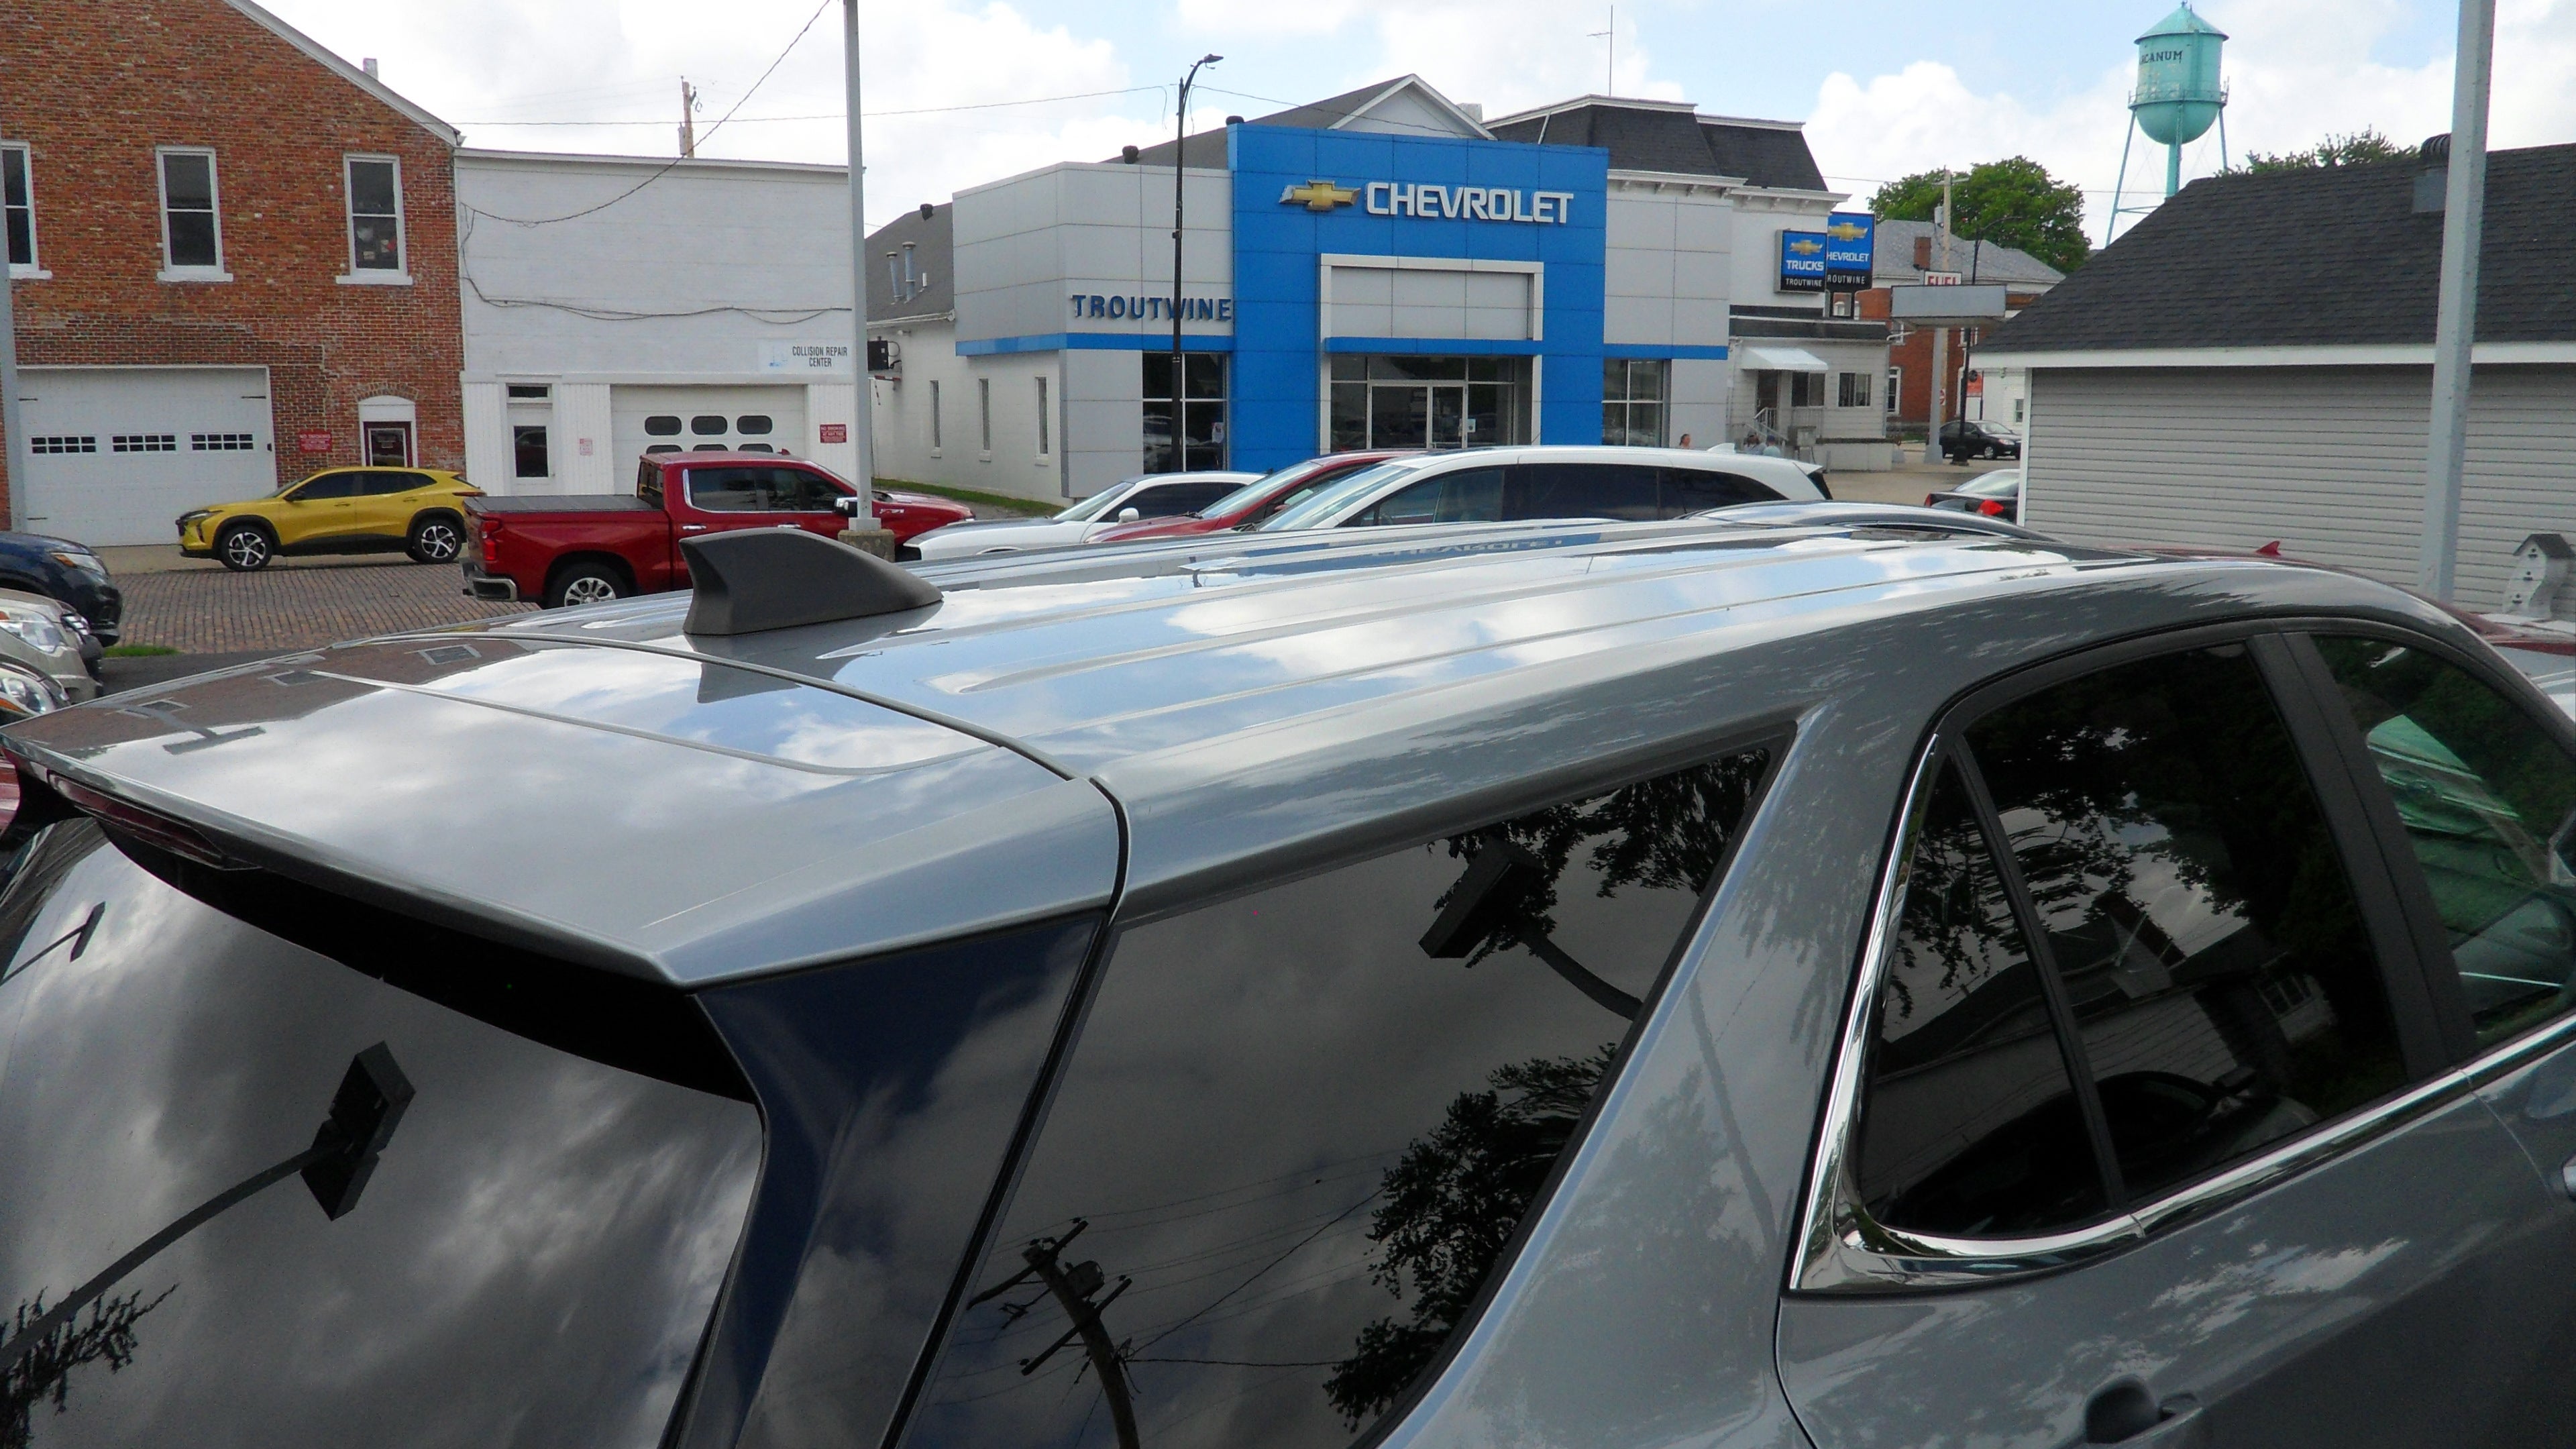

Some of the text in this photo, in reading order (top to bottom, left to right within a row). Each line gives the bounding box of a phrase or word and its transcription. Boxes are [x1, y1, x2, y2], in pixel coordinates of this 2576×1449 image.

[1366, 182, 1574, 223] CHEVROLET
[1826, 251, 1870, 262] HEVROLET
[1786, 260, 1824, 271] TRUCKS
[1786, 278, 1822, 287] TROUTWINE
[1827, 274, 1865, 284] ROUTWINE
[1072, 294, 1231, 320] TROUTWINE
[792, 346, 847, 356] COLLISION REPAIR
[808, 357, 832, 367] CENTER
